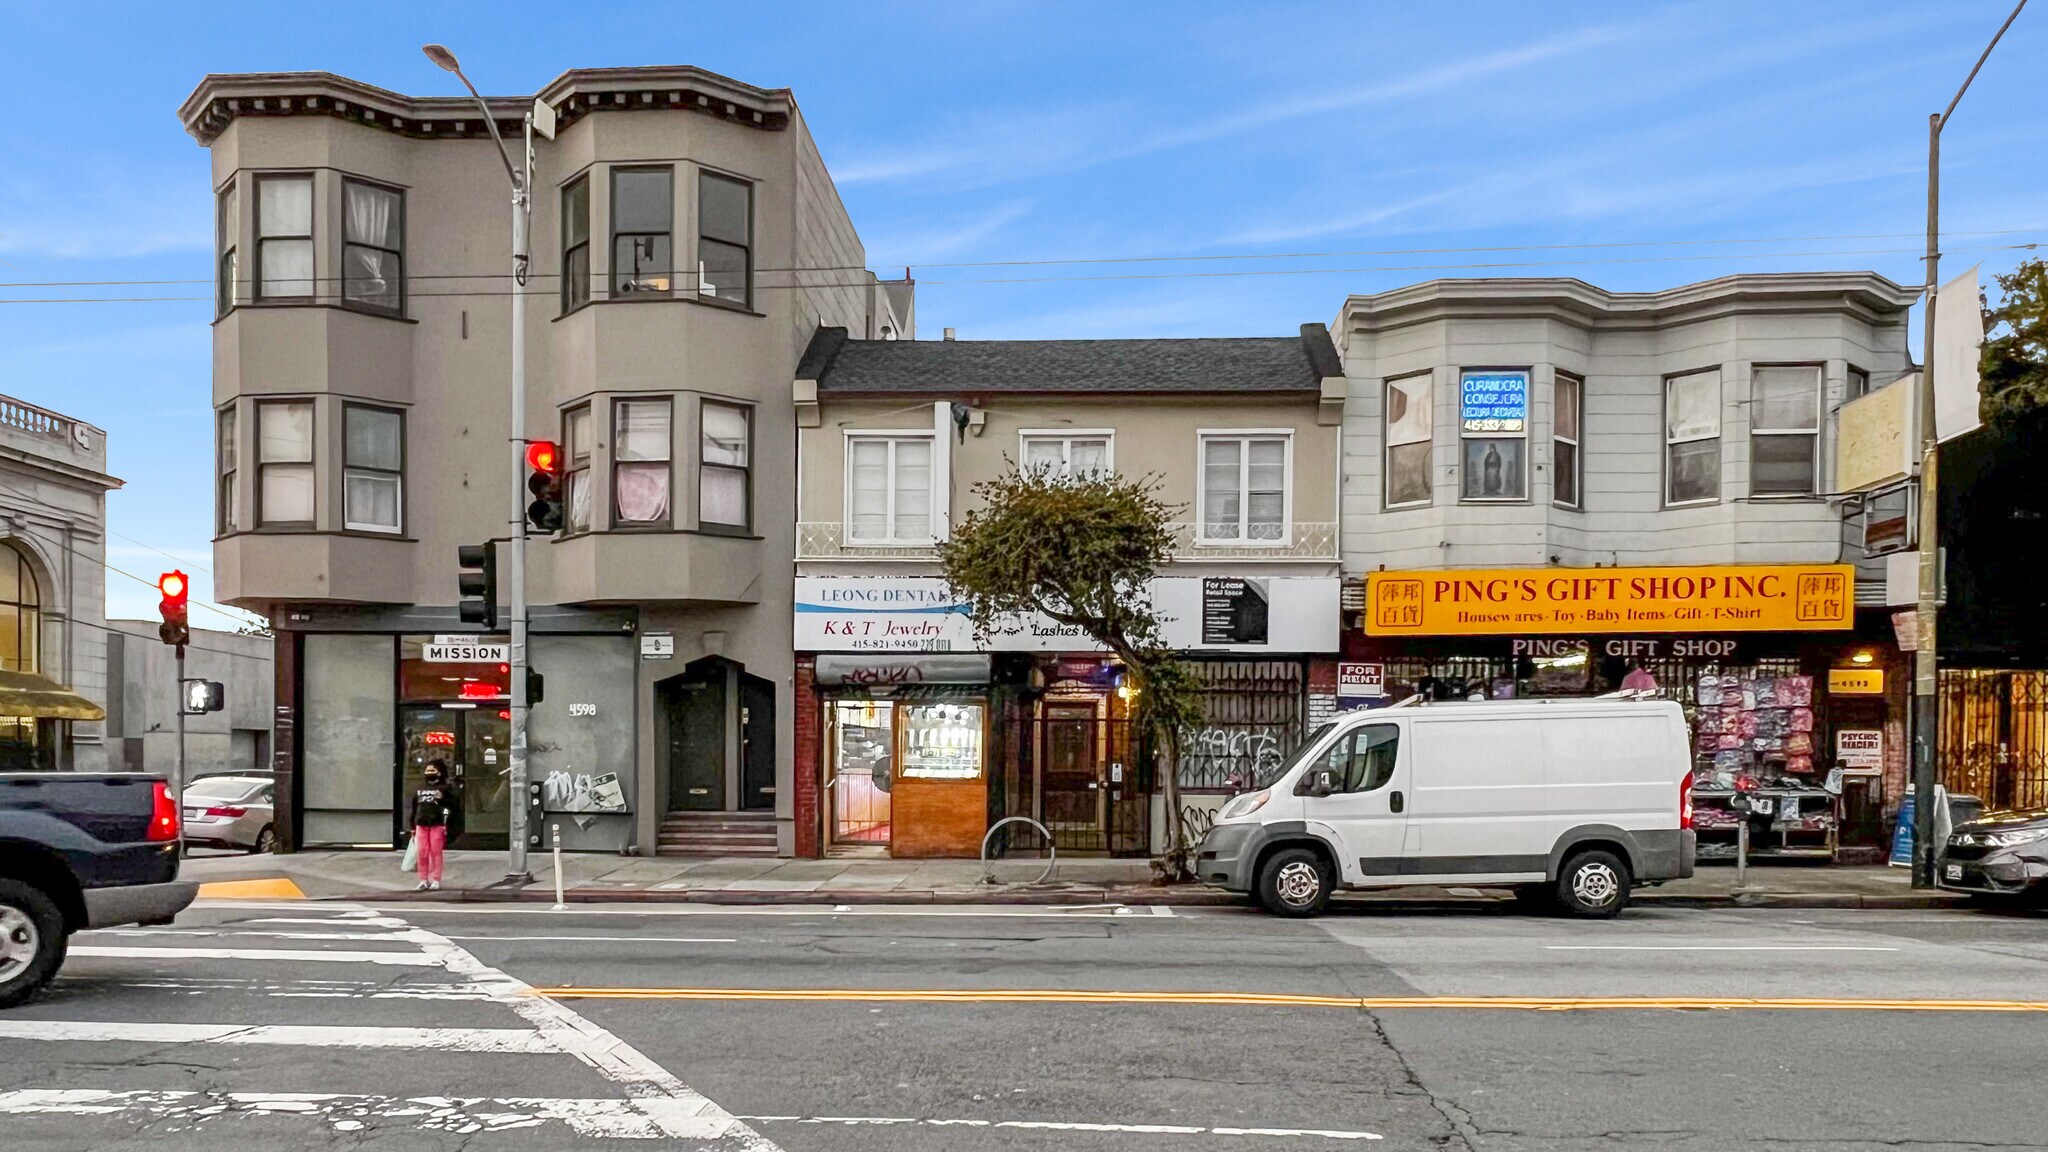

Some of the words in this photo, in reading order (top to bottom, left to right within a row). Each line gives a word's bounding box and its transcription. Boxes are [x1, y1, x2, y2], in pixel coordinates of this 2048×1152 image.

[1464, 380, 1524, 391] CURANDERA
[1464, 393, 1524, 404] CONSEJERA
[1206, 581, 1219, 589] For
[1220, 581, 1244, 589] Lease
[1434, 579, 1537, 603] PING'S
[1546, 578, 1622, 601] GIFT
[1630, 576, 1716, 600] SHOP
[1723, 575, 1786, 599] INC.
[822, 589, 878, 602] LEONG
[1552, 609, 1576, 624] Toy
[1586, 609, 1620, 624] Baby
[1627, 608, 1665, 620] Items
[1674, 607, 1701, 619] Gift
[1712, 607, 1761, 619] T-Shirt
[823, 621, 839, 636] K
[842, 620, 856, 636] &
[863, 621, 875, 636] T
[882, 620, 943, 639] Jewelry
[1030, 622, 1079, 637] Lashes
[430, 647, 501, 659] MISSION
[1512, 639, 1589, 655] PING'S
[1605, 640, 1659, 656] GIFT
[1672, 640, 1737, 656] SHOP
[1346, 666, 1375, 675] FOR
[1341, 674, 1380, 684] RENT
[569, 703, 597, 716] 4598
[1841, 733, 1879, 741] PSYCHIC
